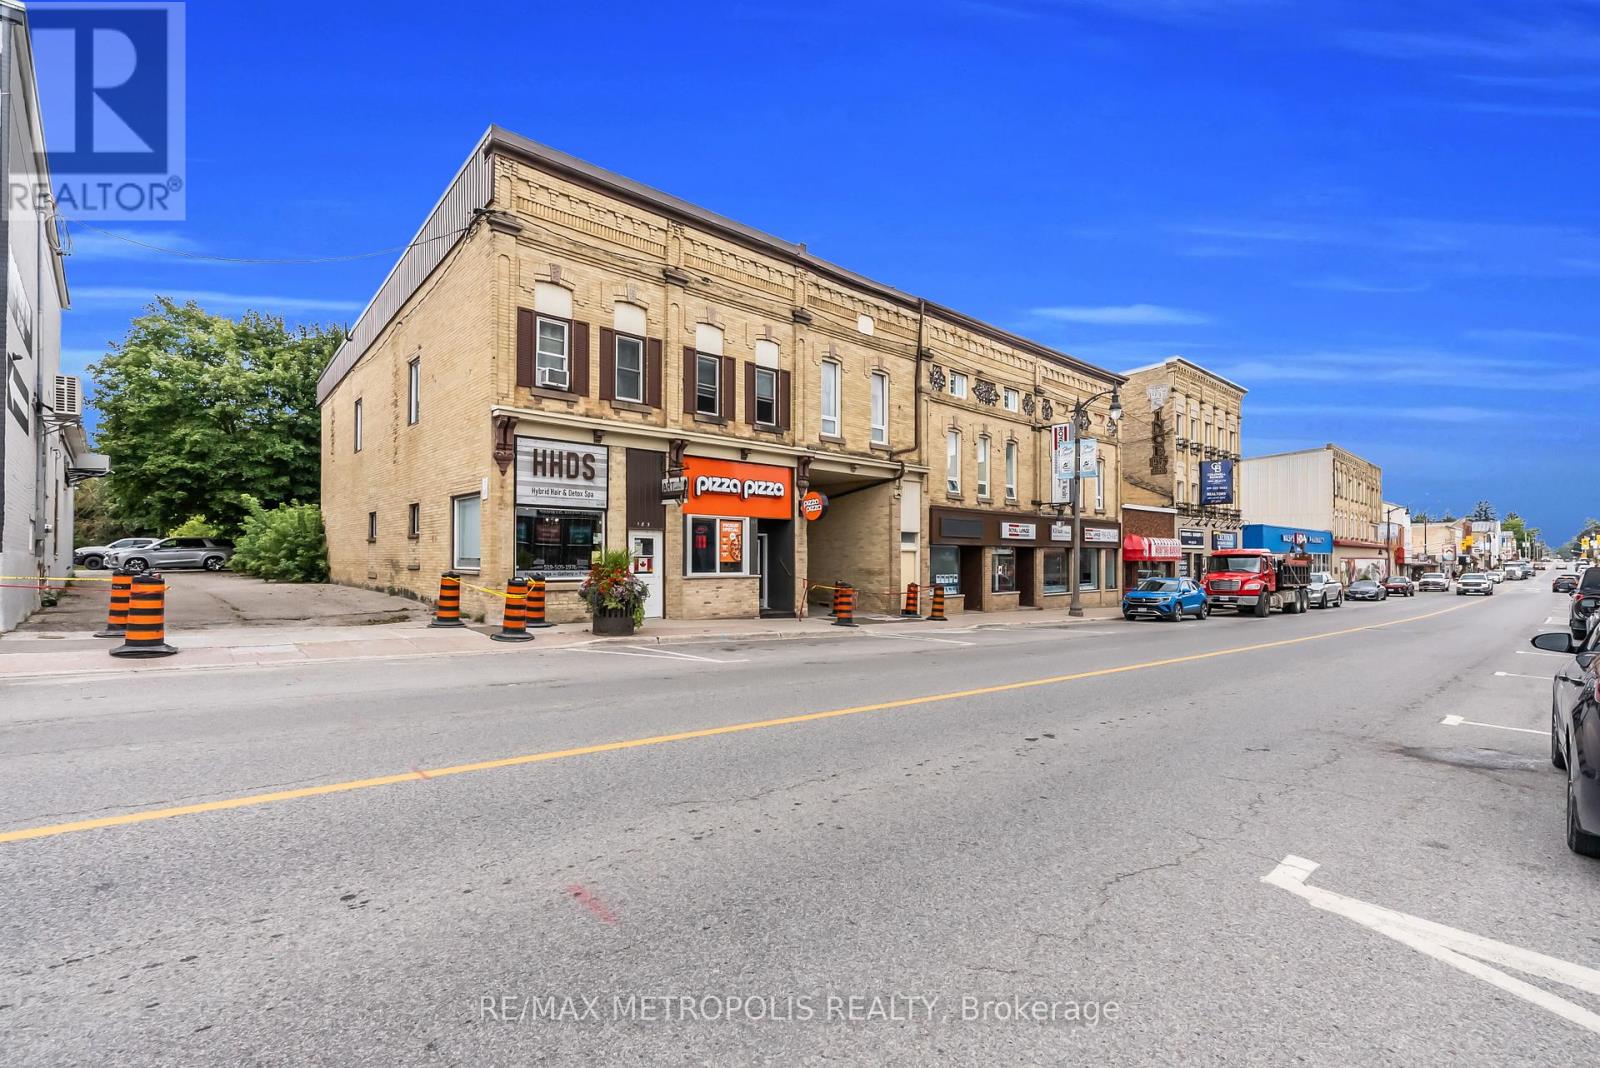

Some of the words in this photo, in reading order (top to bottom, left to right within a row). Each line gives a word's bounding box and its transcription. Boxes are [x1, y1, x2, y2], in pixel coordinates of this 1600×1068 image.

[533, 448, 595, 481] HHDS
[532, 488, 550, 496] Hybrid
[696, 476, 741, 496] pizza
